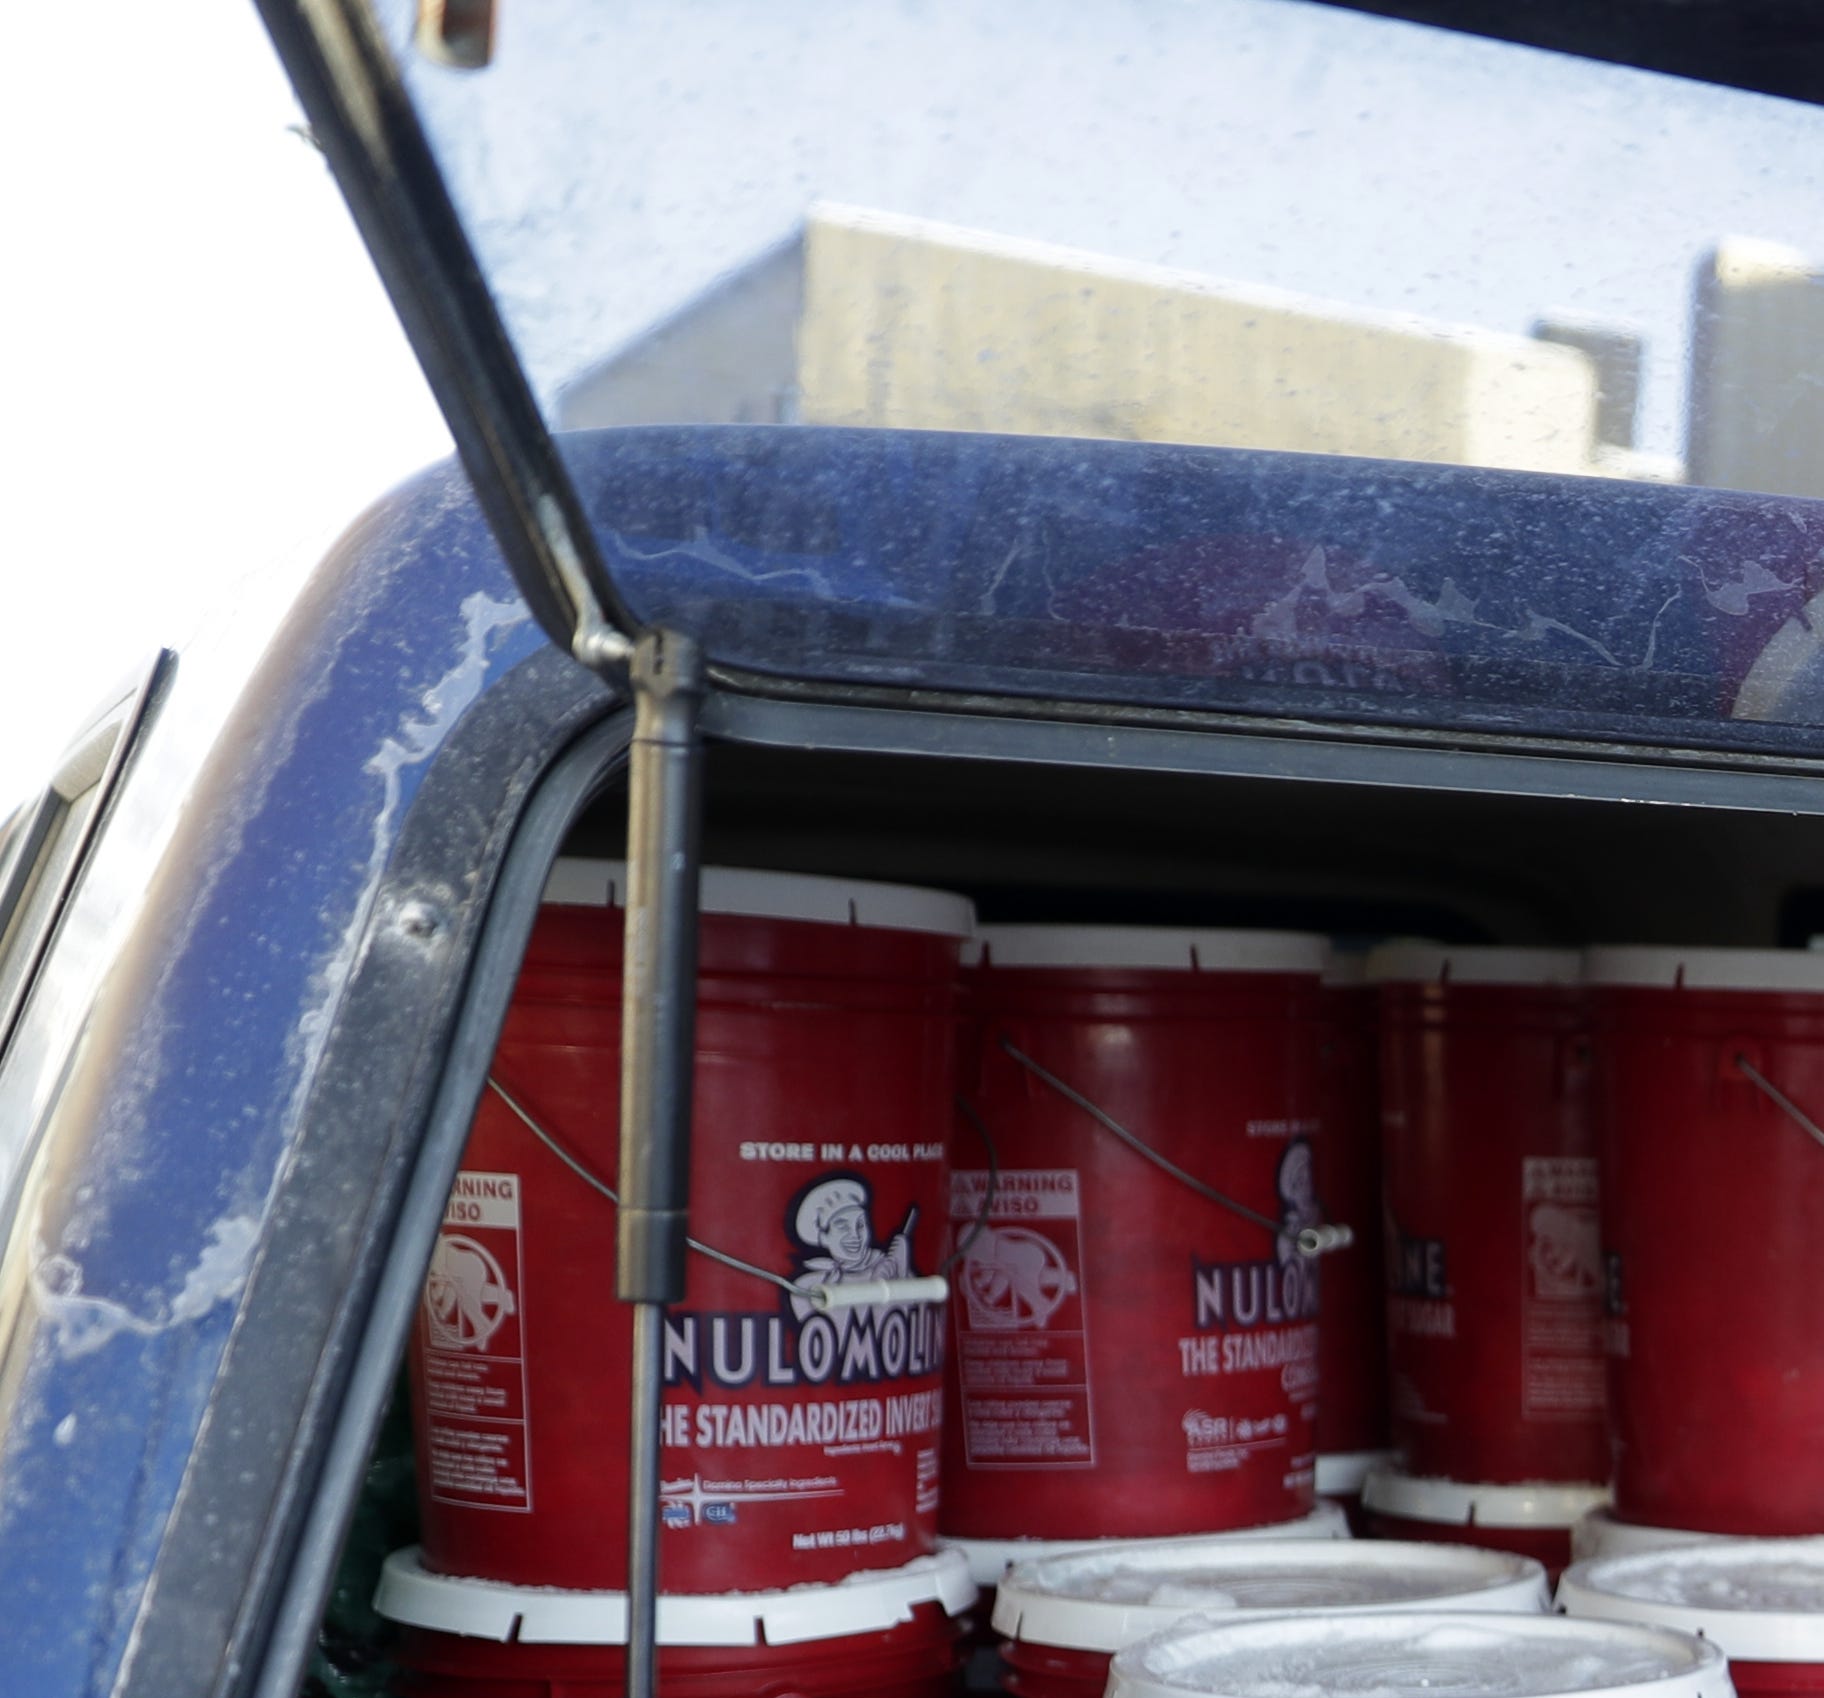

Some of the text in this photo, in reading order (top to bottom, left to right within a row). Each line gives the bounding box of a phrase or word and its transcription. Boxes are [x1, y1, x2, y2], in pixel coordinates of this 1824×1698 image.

[740, 1141, 814, 1161] STORE
[821, 1143, 843, 1161] IN
[849, 1144, 862, 1161] A
[867, 1143, 909, 1161] COOL
[453, 1179, 513, 1199] RNING
[1178, 1335, 1218, 1376] THE
[660, 1404, 689, 1447] HE
[696, 1398, 881, 1447] STANDARDIZED
